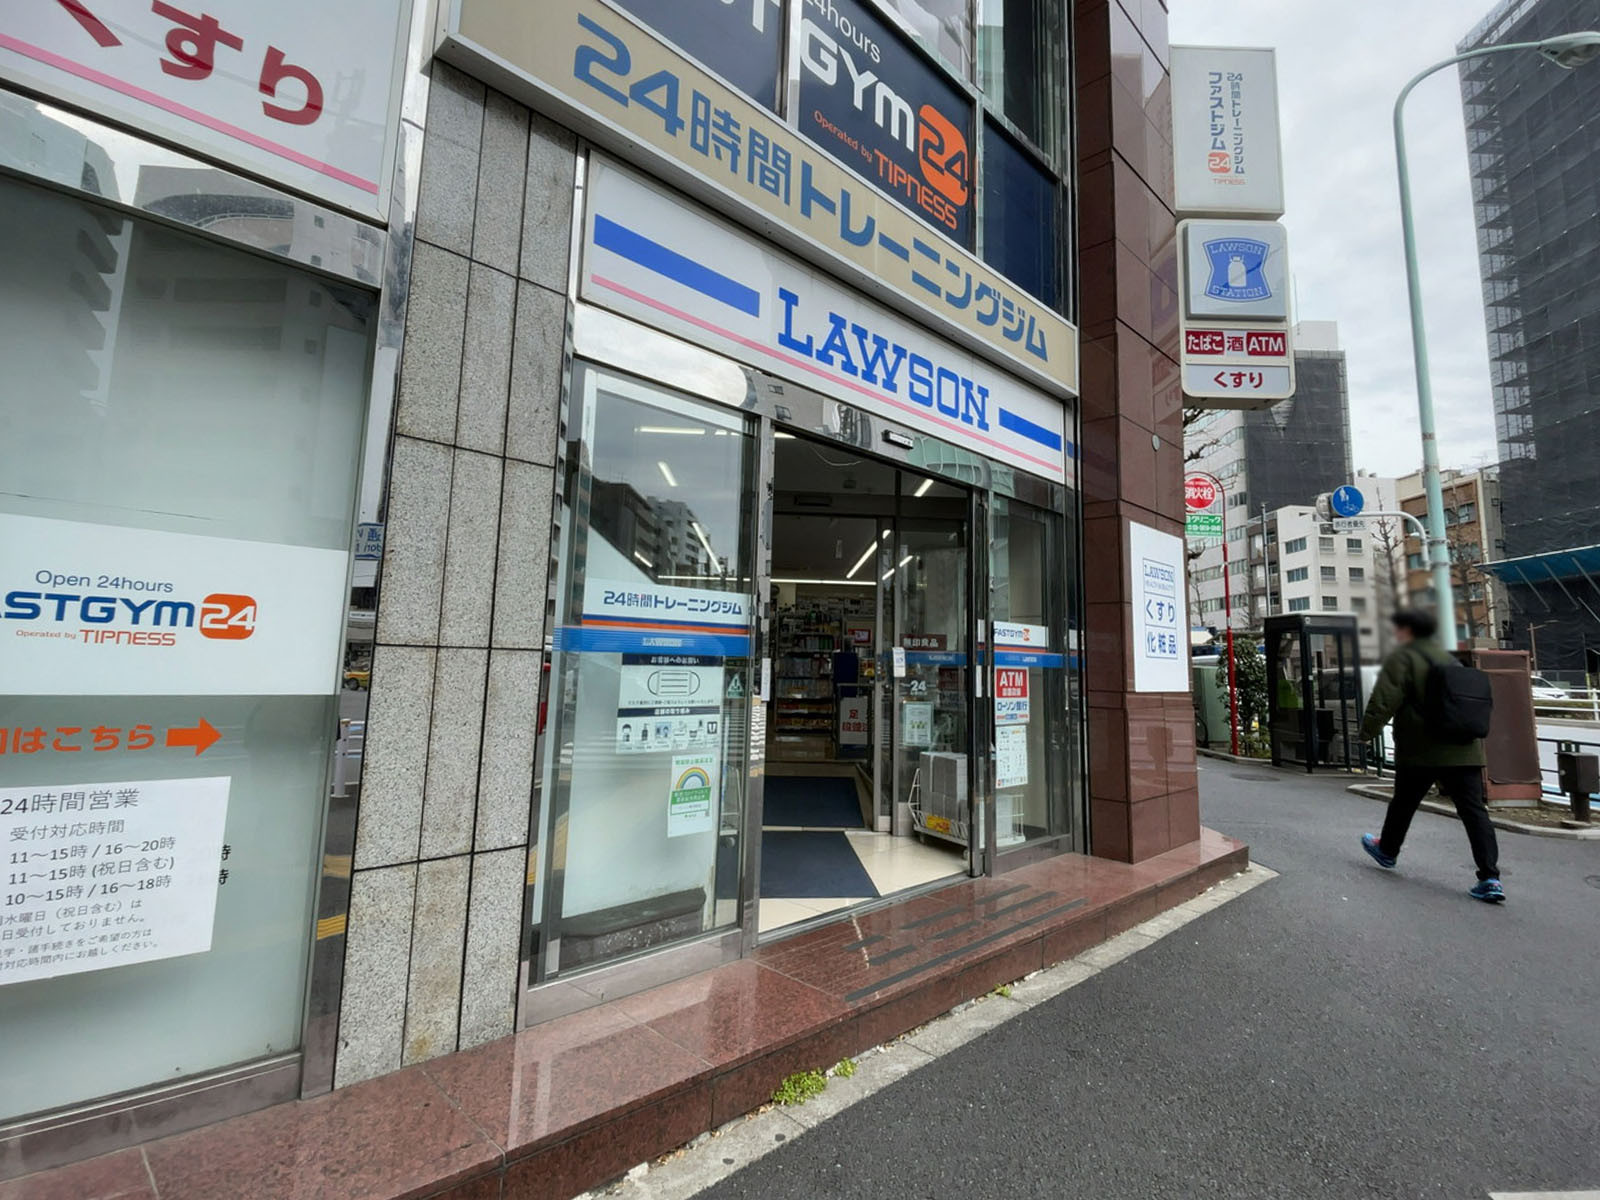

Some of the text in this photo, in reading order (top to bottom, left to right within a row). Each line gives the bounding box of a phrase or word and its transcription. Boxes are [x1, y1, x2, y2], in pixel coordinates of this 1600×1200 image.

[804, 0, 881, 63] 4hours
[814, 110, 859, 149] Operated
[860, 144, 873, 162] by
[574, 13, 1048, 362] 24時間トレーニングジム
[1209, 243, 1262, 255] LAWSON
[1211, 285, 1263, 297] STATION
[1187, 335, 1284, 352] たばこ 酒 ATM
[778, 287, 989, 431] LAWSON
[1213, 371, 1263, 388] くすり
[35, 570, 174, 593] Open 24hours
[0, 591, 257, 634] STGYM24
[603, 590, 742, 615] 24時間トレーニングジム
[1146, 598, 1175, 623] くすり
[16, 630, 61, 638] Operated
[64, 631, 77, 640] by
[1147, 632, 1177, 655] 化粧品
[910, 680, 927, 691] 24
[1000, 671, 1023, 687] ATM
[0, 788, 140, 815] 24時間営業
[10, 819, 125, 842] 受付対応時間
[0, 900, 142, 927] 水曜日（祝日含む）は
[0, 940, 158, 971] 対応時間内にお越しください。
